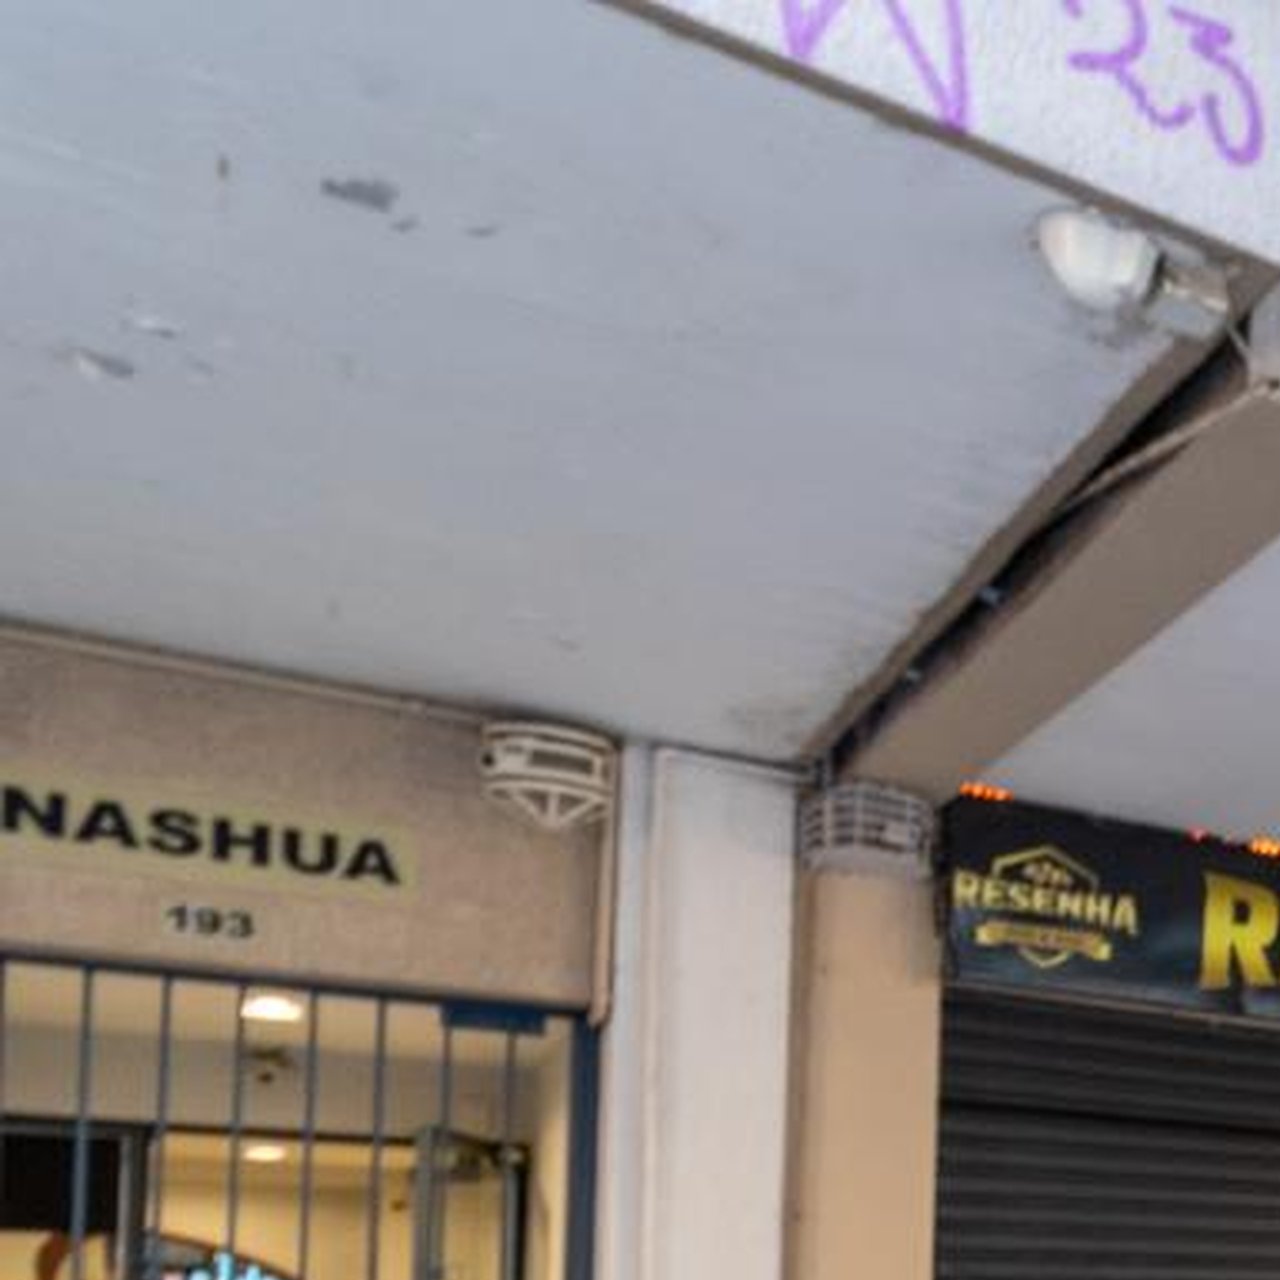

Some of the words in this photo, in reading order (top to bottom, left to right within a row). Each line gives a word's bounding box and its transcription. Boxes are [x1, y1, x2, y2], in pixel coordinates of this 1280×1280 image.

[2, 785, 403, 885] NASHUA
[165, 904, 256, 939] 193
[953, 867, 1139, 937] RESENHA
